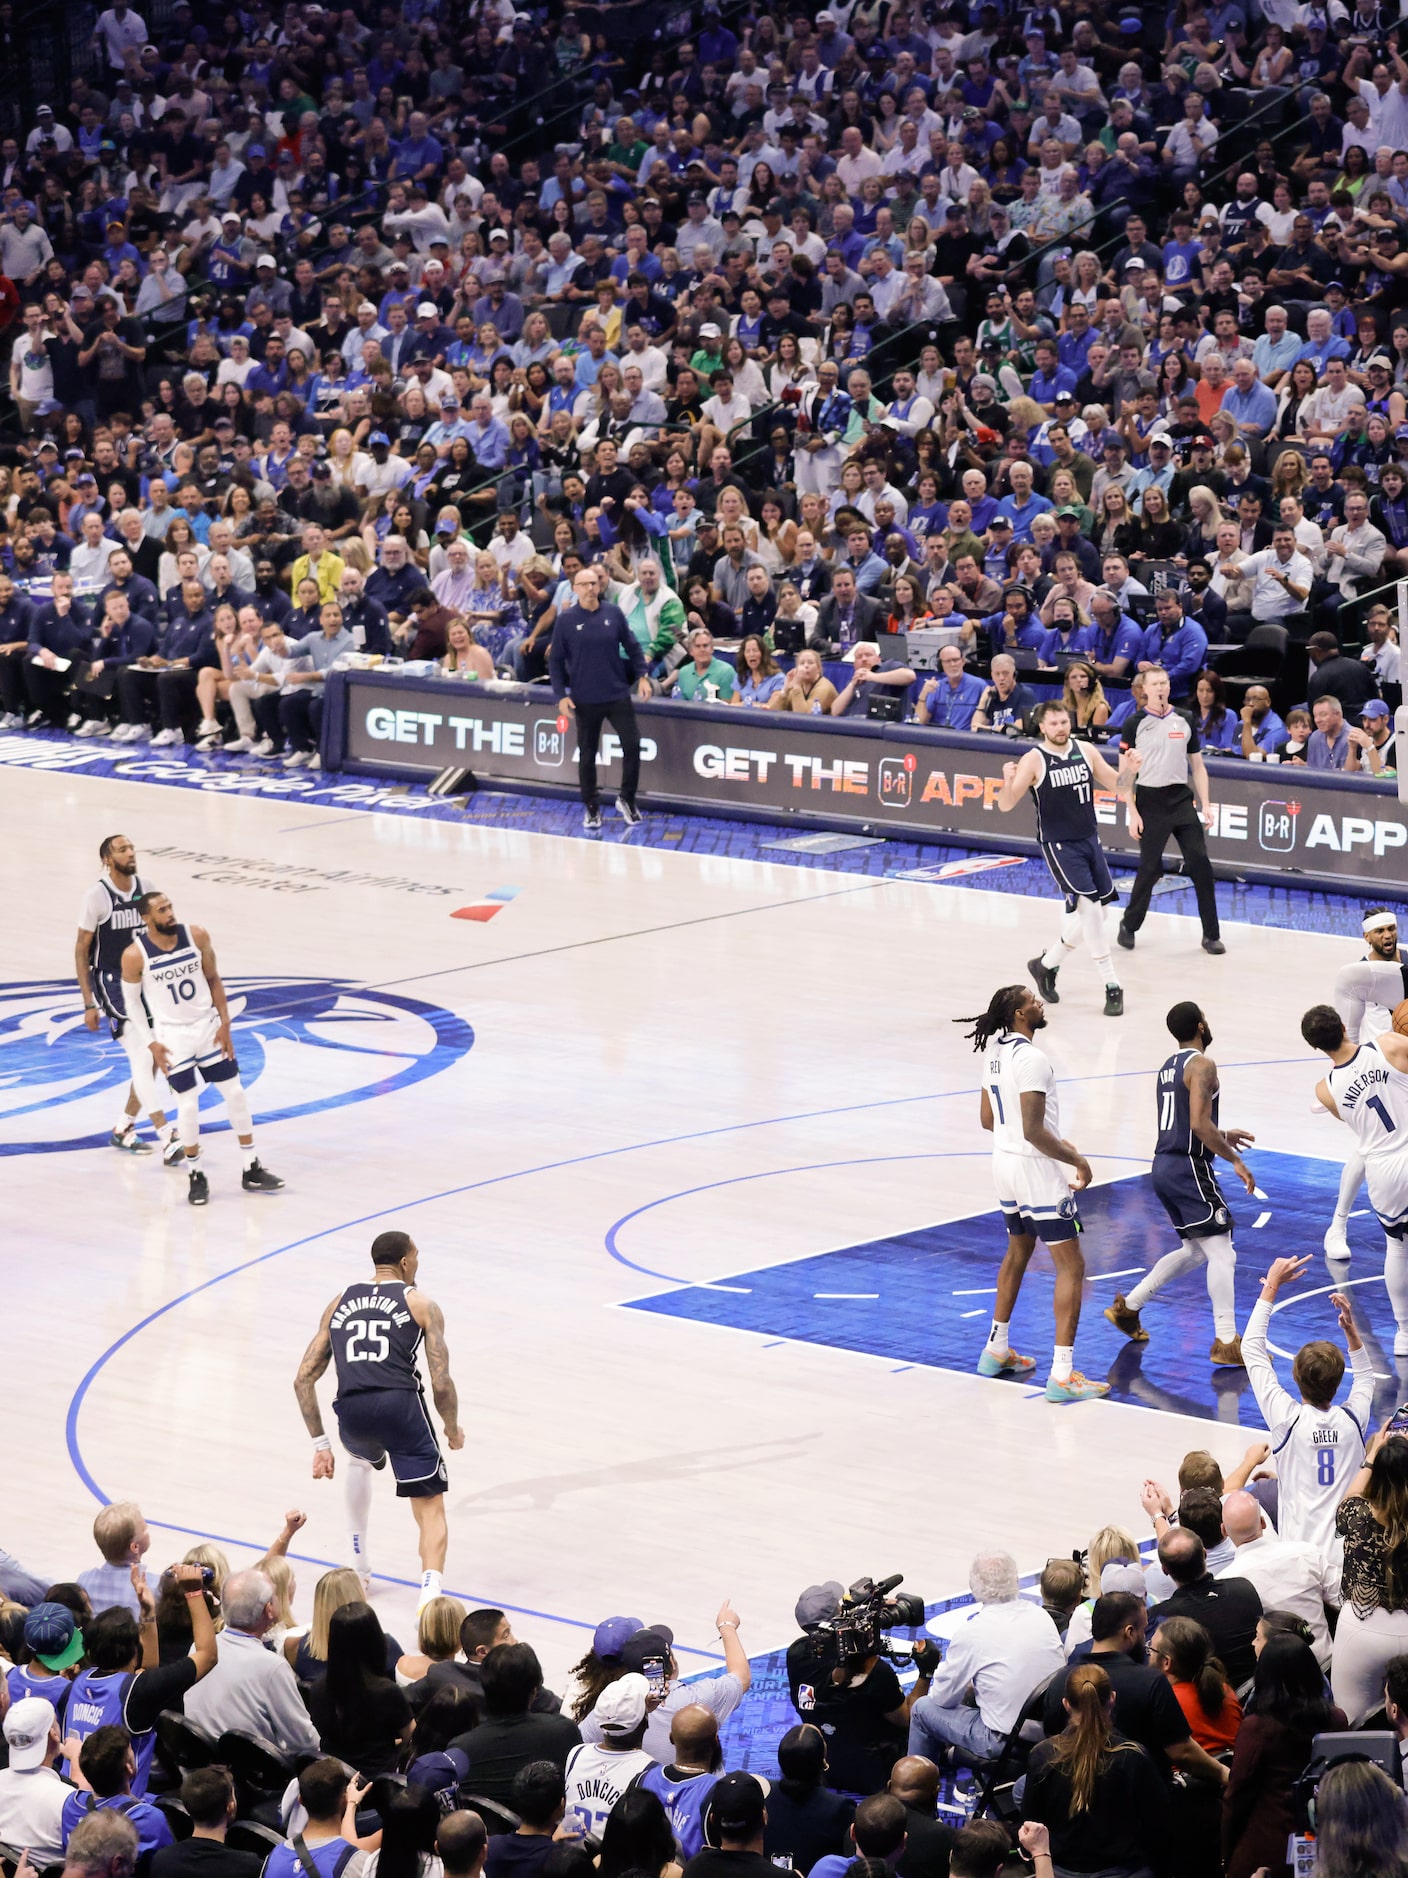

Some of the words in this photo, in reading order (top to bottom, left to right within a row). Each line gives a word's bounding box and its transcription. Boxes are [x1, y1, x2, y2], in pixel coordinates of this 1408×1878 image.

[365, 707, 443, 745] GET
[448, 716, 525, 756] THE
[115, 761, 315, 794] Google
[302, 783, 465, 810] Pixel
[693, 744, 777, 783] GET
[784, 754, 869, 795] THE
[1049, 763, 1090, 789] MAVS
[1072, 782, 1091, 804] 77
[1304, 813, 1408, 856] APP
[138, 846, 319, 878] American
[313, 870, 465, 896] Airlines
[192, 870, 329, 894] Center
[152, 961, 200, 983] WOLVES
[166, 978, 197, 1005] 10
[1342, 1069, 1390, 1110] ANDERSON
[1365, 1094, 1397, 1133] 1
[330, 1295, 399, 1329] WASHINGTON
[391, 1310, 411, 1329] JR.
[345, 1319, 387, 1363] 25
[1312, 1429, 1339, 1444] GREEN
[1317, 1448, 1335, 1487] 8
